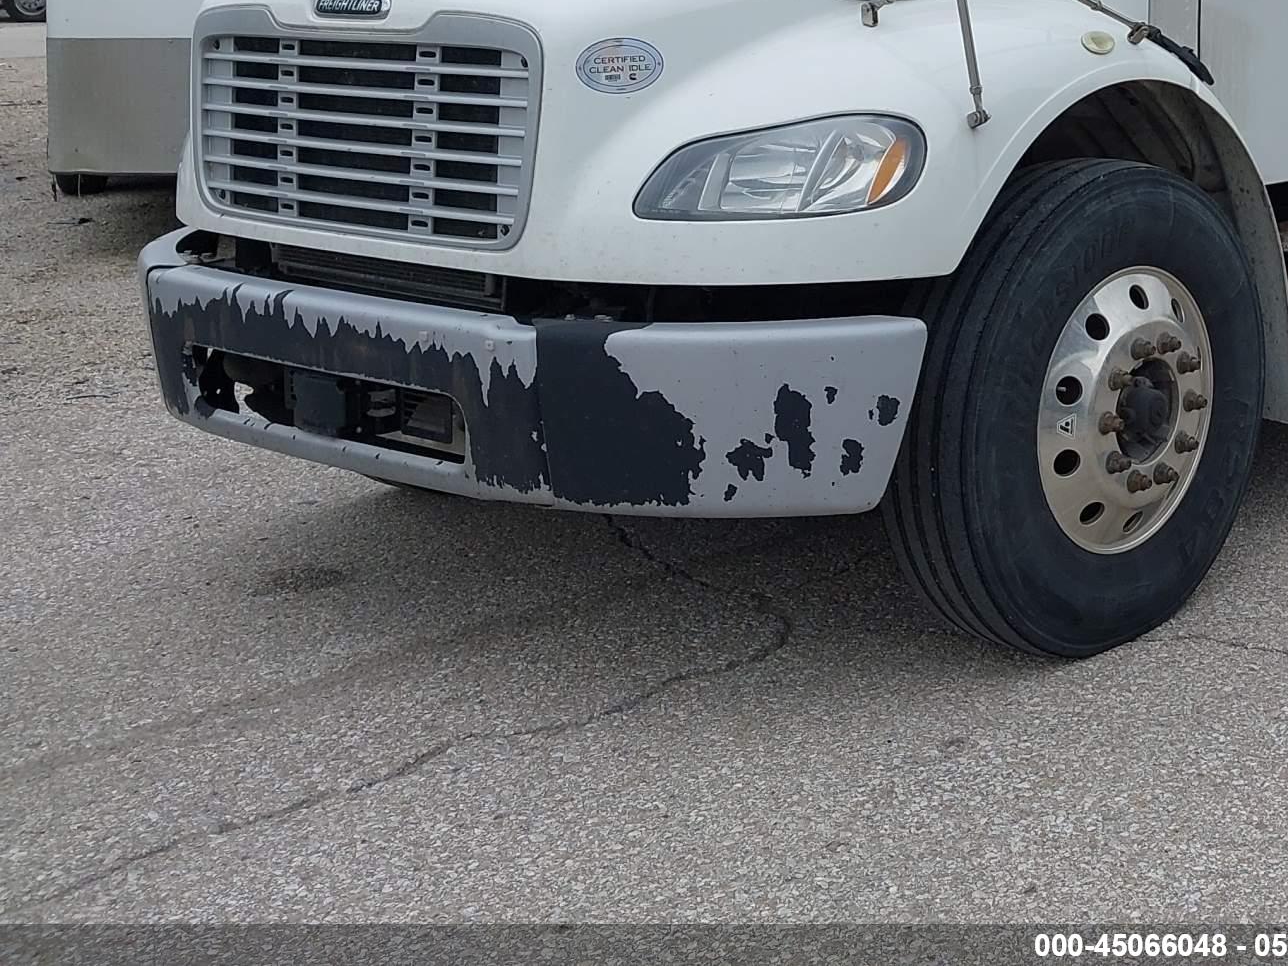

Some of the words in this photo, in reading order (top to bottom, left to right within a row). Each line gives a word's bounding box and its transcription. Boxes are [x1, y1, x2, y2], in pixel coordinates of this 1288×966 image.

[593, 55, 646, 65] CERTIFIED
[589, 65, 625, 74] CLEAN
[628, 63, 652, 72] IDLE
